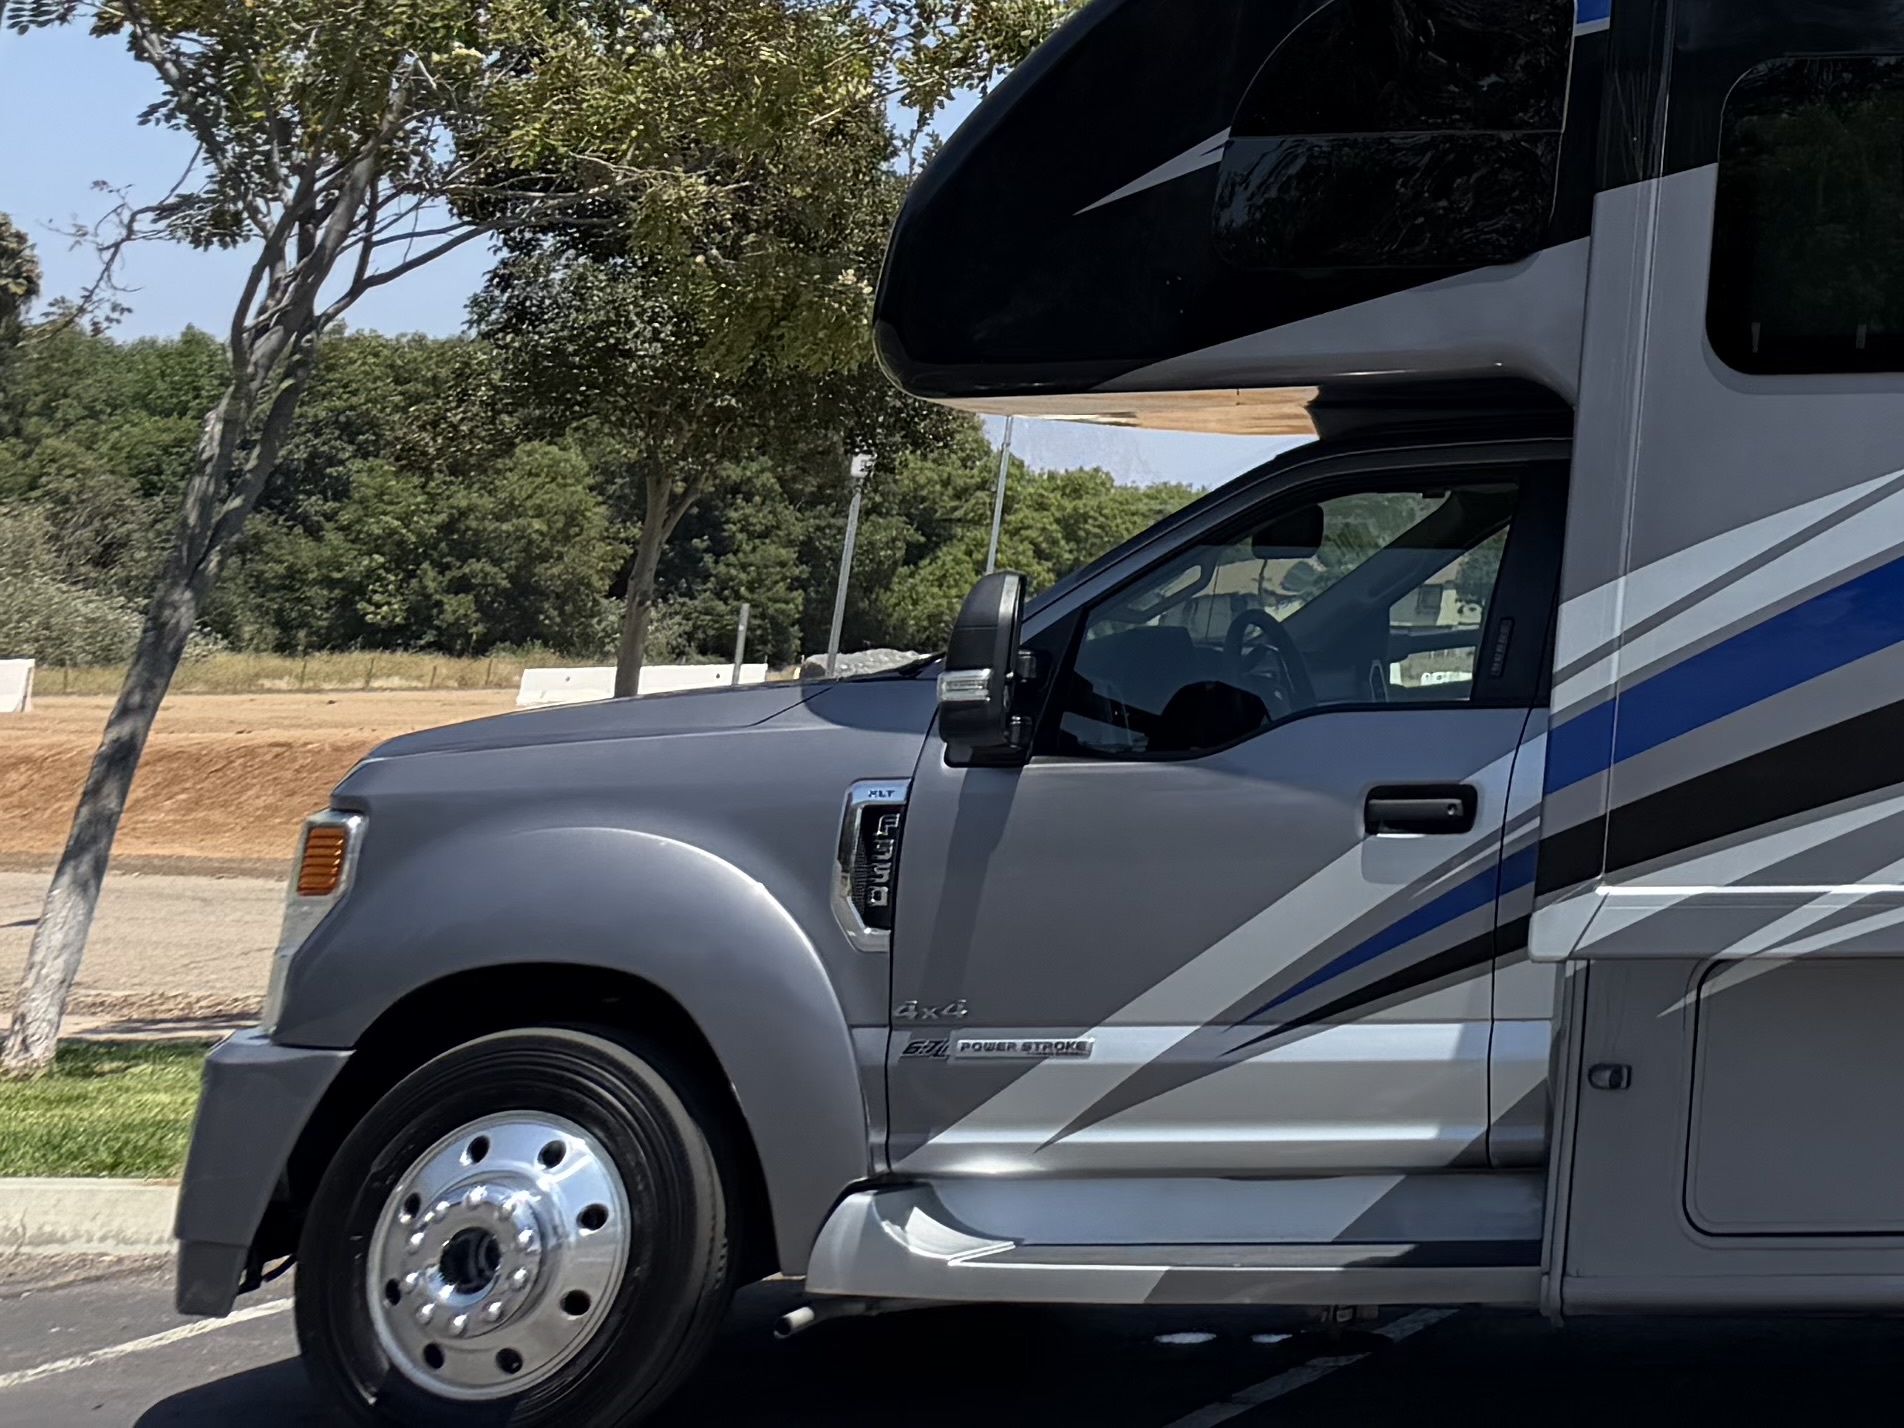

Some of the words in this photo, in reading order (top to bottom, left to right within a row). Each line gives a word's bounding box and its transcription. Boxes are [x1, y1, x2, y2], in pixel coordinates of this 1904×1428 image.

[868, 789, 895, 799] XLT
[960, 1041, 1018, 1053] POWER
[1022, 1040, 1089, 1053] STROKE
